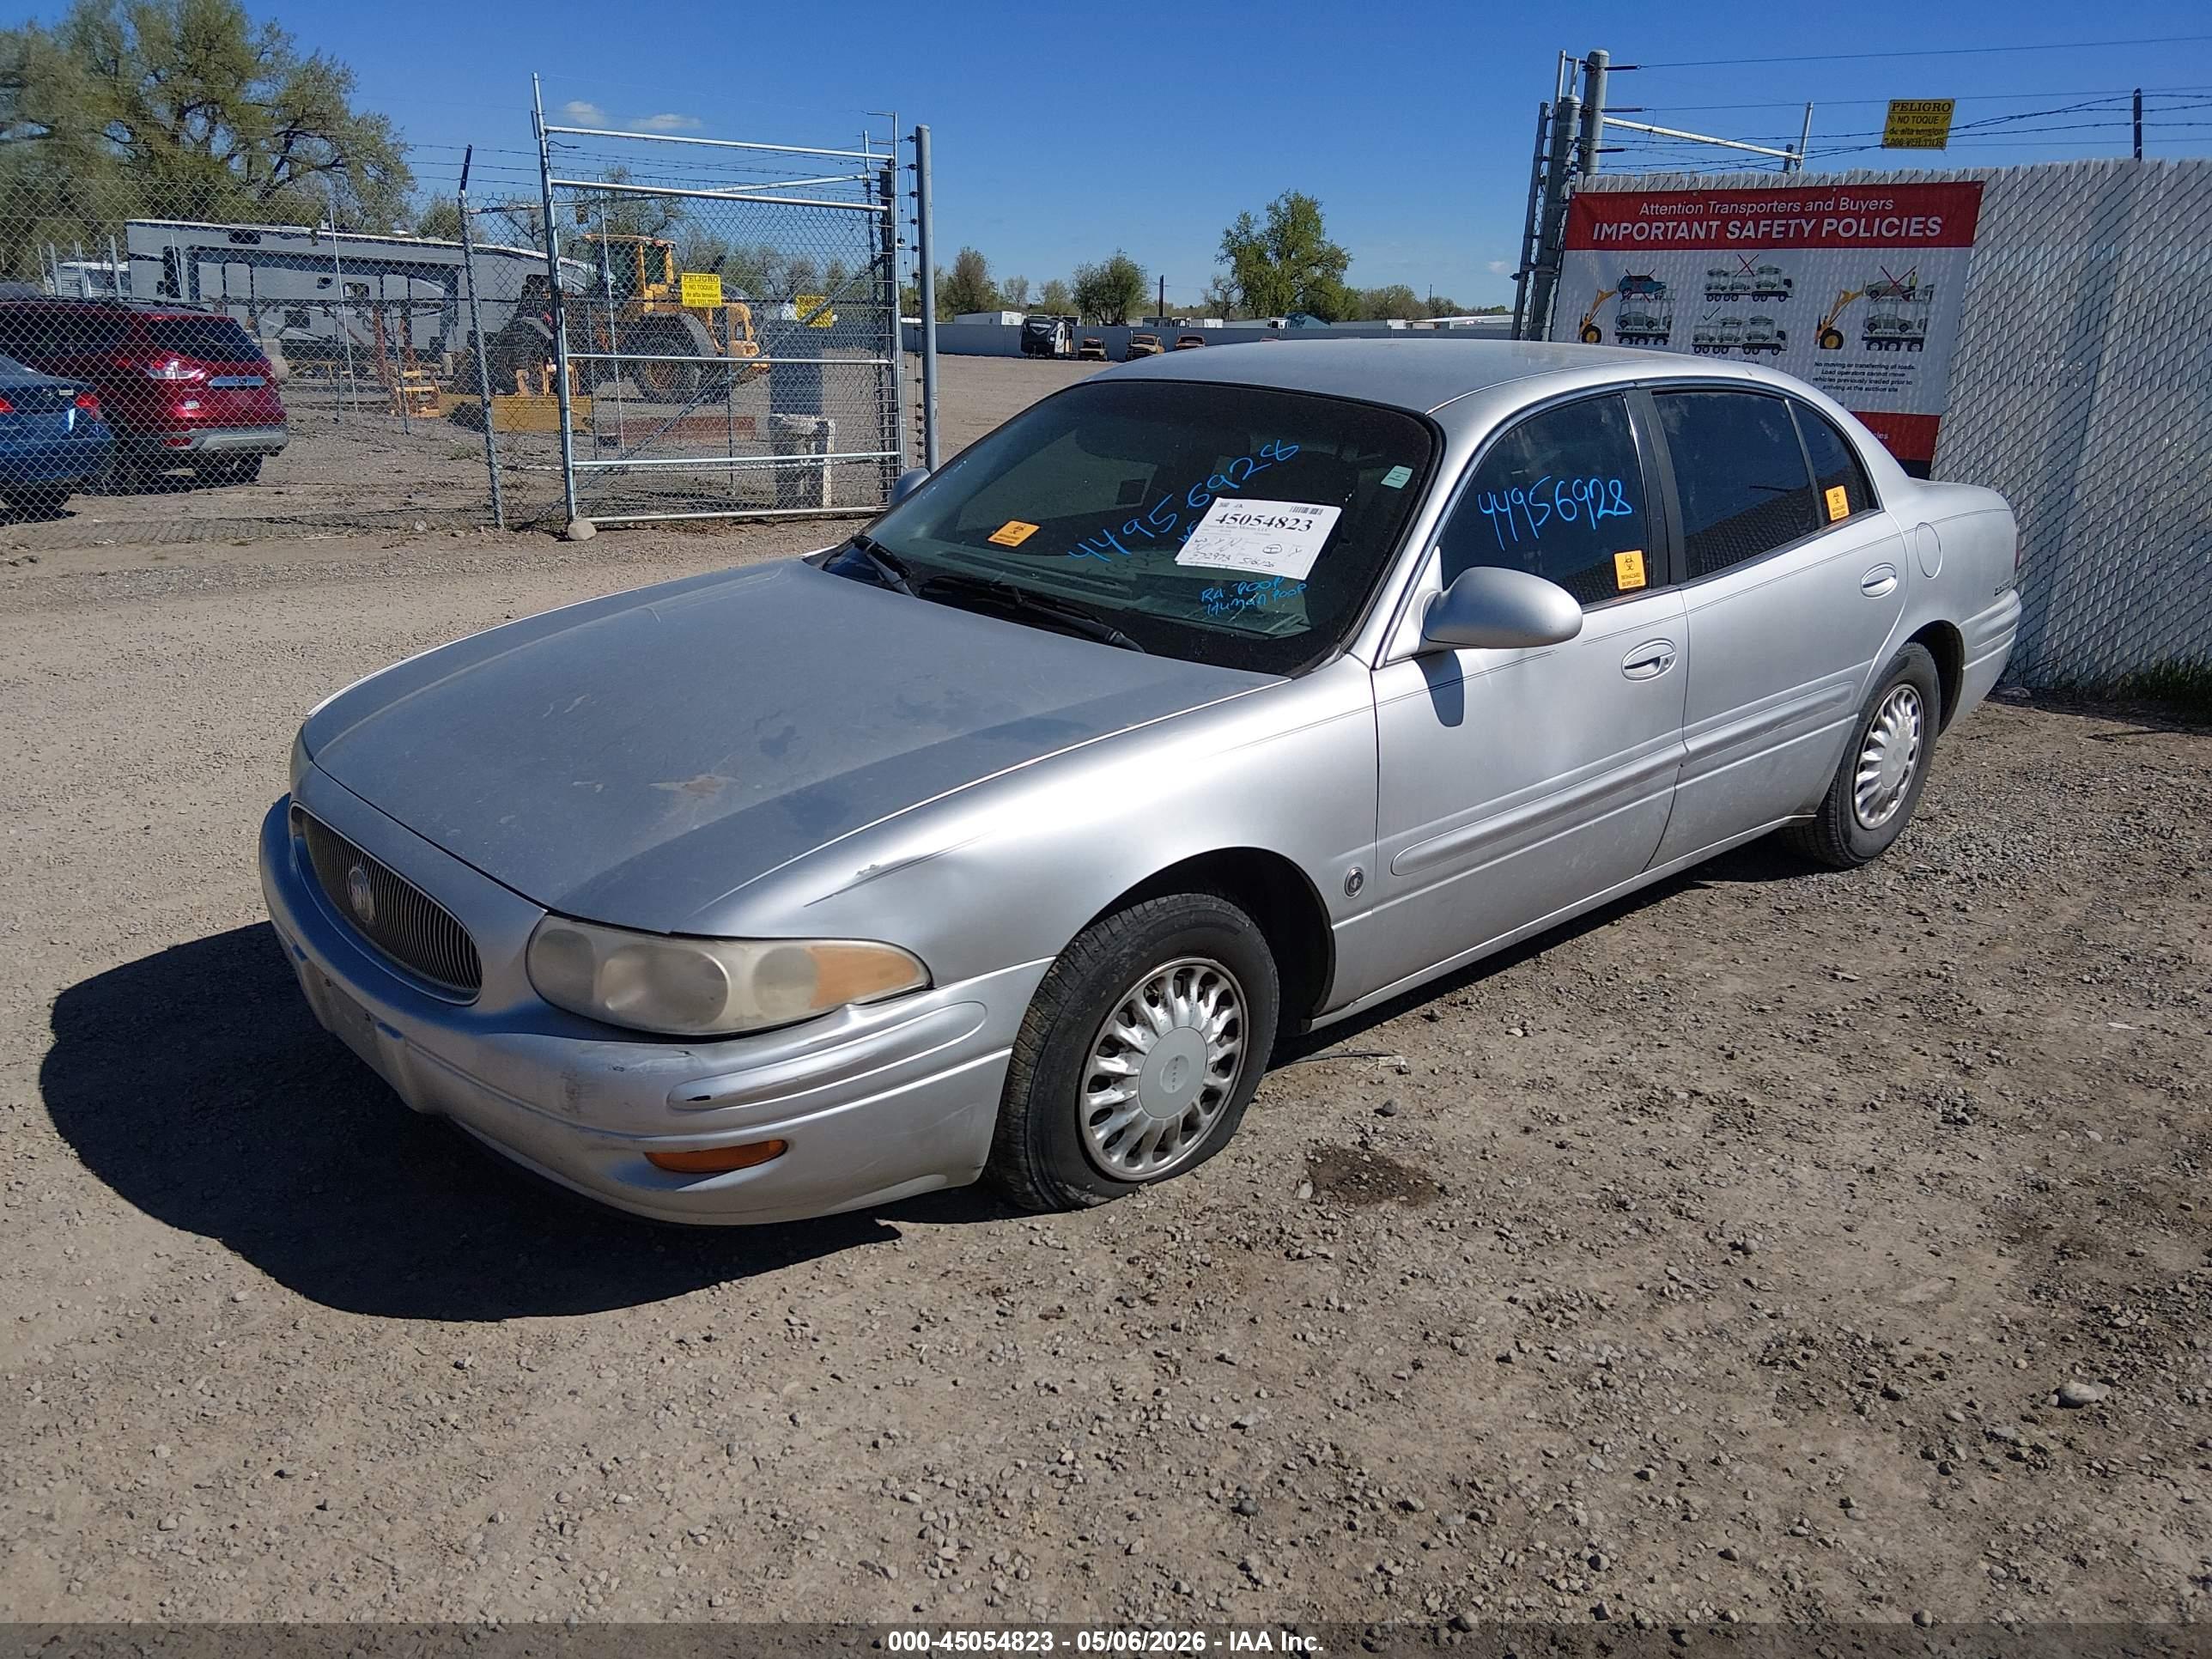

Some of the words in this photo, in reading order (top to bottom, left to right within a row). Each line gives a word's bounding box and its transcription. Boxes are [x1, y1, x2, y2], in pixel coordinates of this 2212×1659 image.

[1892, 102, 1951, 112] PELIGRO
[1897, 115, 1909, 125] NO
[1911, 115, 1939, 125] TOQUE
[1638, 202, 1704, 216] Attention
[1709, 200, 1801, 217] Transporters
[1804, 197, 1835, 212] and
[1838, 197, 1894, 213] Buyers
[1592, 221, 1721, 241] IMPORTANT
[1726, 218, 1817, 240] SAFETY
[1821, 216, 1942, 238] POLICIES
[684, 275, 719, 283] PELIGRO
[1068, 439, 1299, 563] 44956928
[1216, 513, 1313, 532] 45054823
[1478, 475, 1633, 551] 44956928
